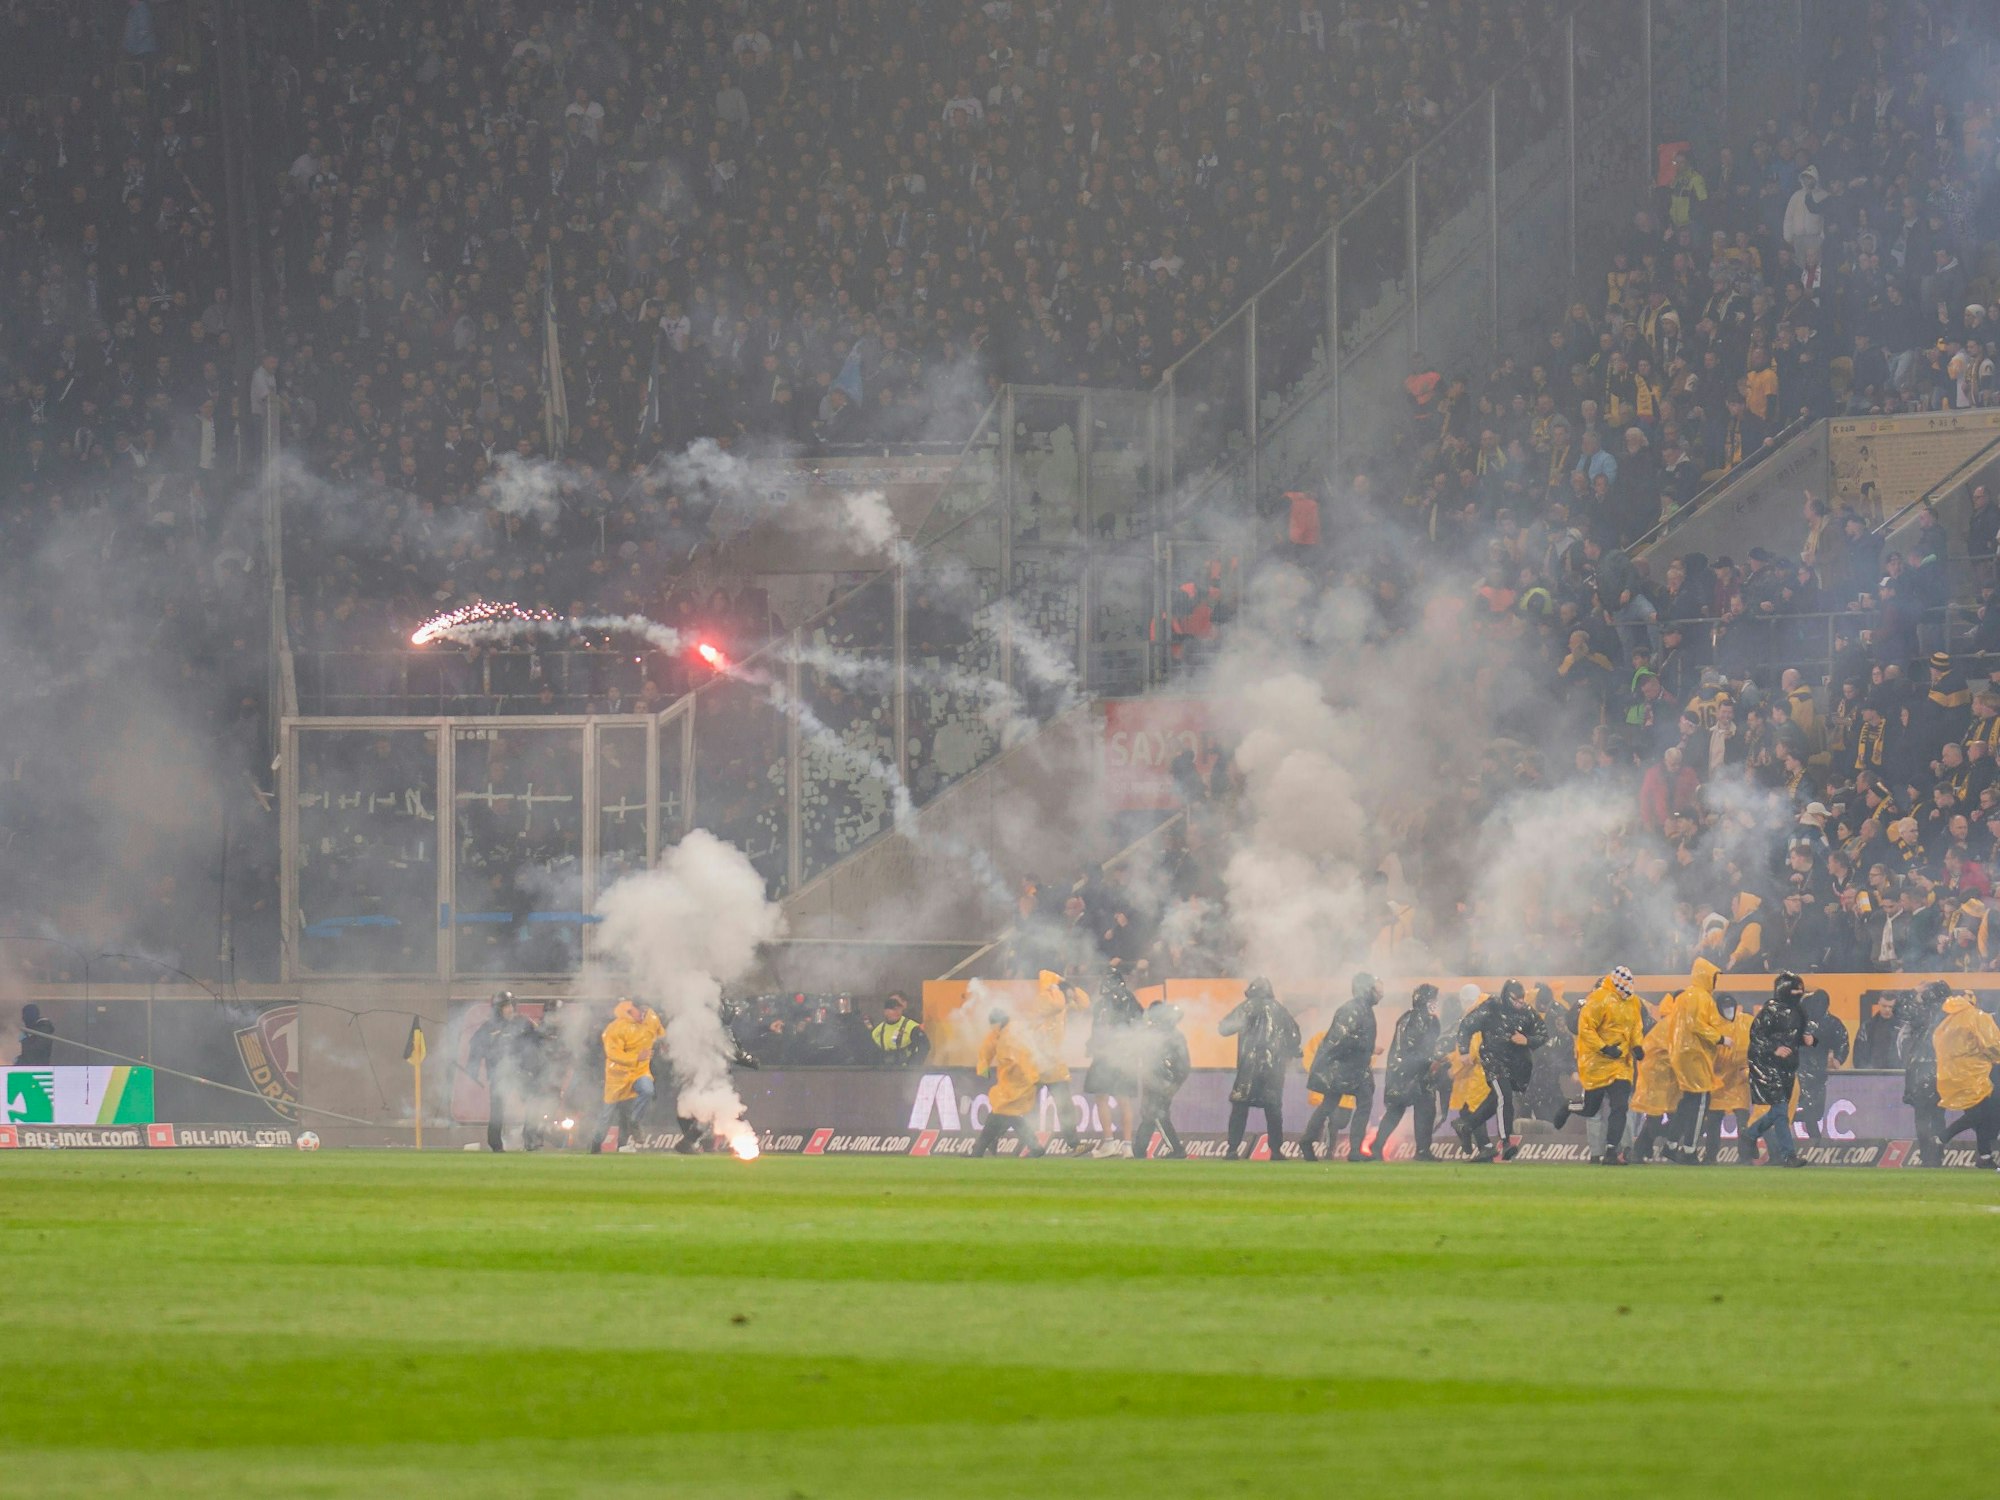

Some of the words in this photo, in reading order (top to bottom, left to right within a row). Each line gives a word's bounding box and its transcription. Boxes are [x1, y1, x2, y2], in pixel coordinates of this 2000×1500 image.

[25, 1131, 139, 1147] ALL-INKL.COM
[180, 1130, 292, 1145] ALL-INKL.COM
[827, 1135, 911, 1152] ALL-INKL.COM
